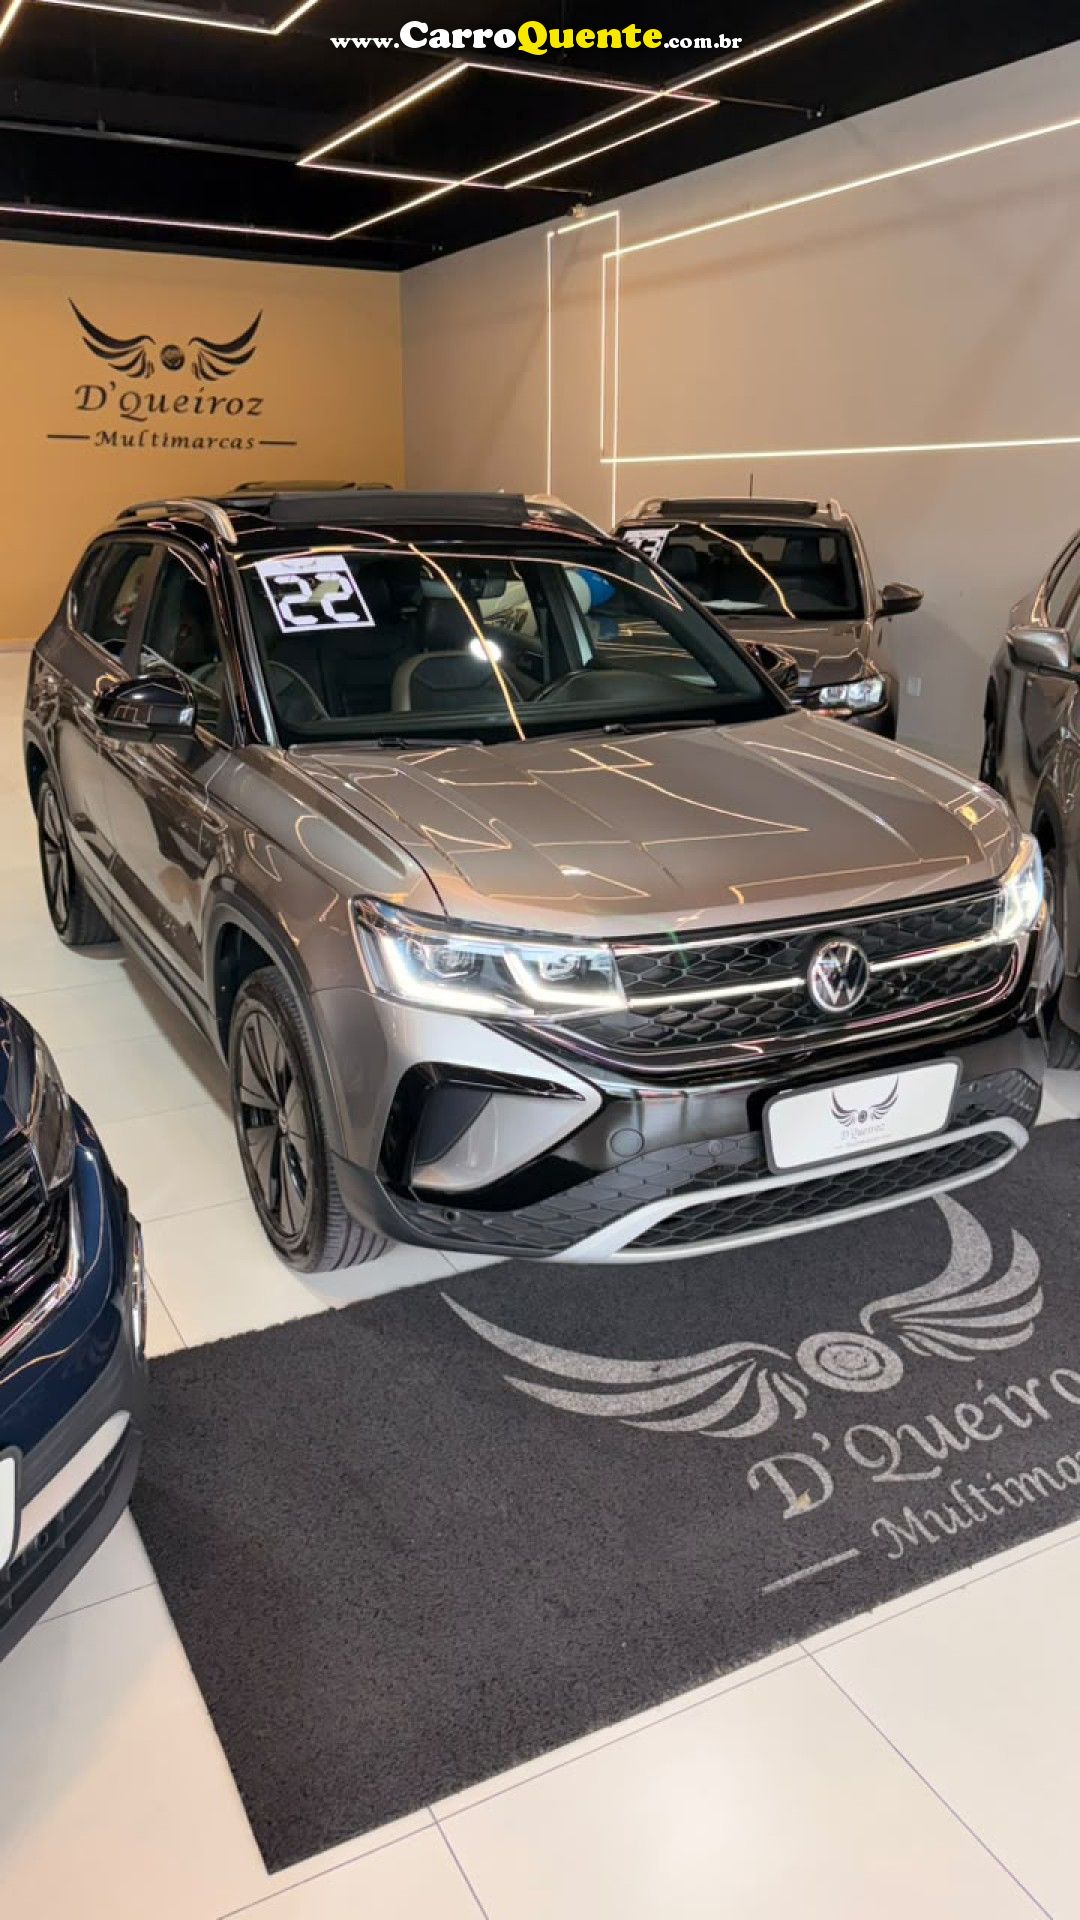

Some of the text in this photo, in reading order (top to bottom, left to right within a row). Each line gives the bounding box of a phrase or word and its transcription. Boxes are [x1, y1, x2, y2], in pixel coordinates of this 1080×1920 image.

[74, 380, 265, 423] D'Queiroz
[94, 428, 255, 450] Multimarcas
[274, 572, 361, 625] 22
[871, 1450, 1080, 1559] Multima
